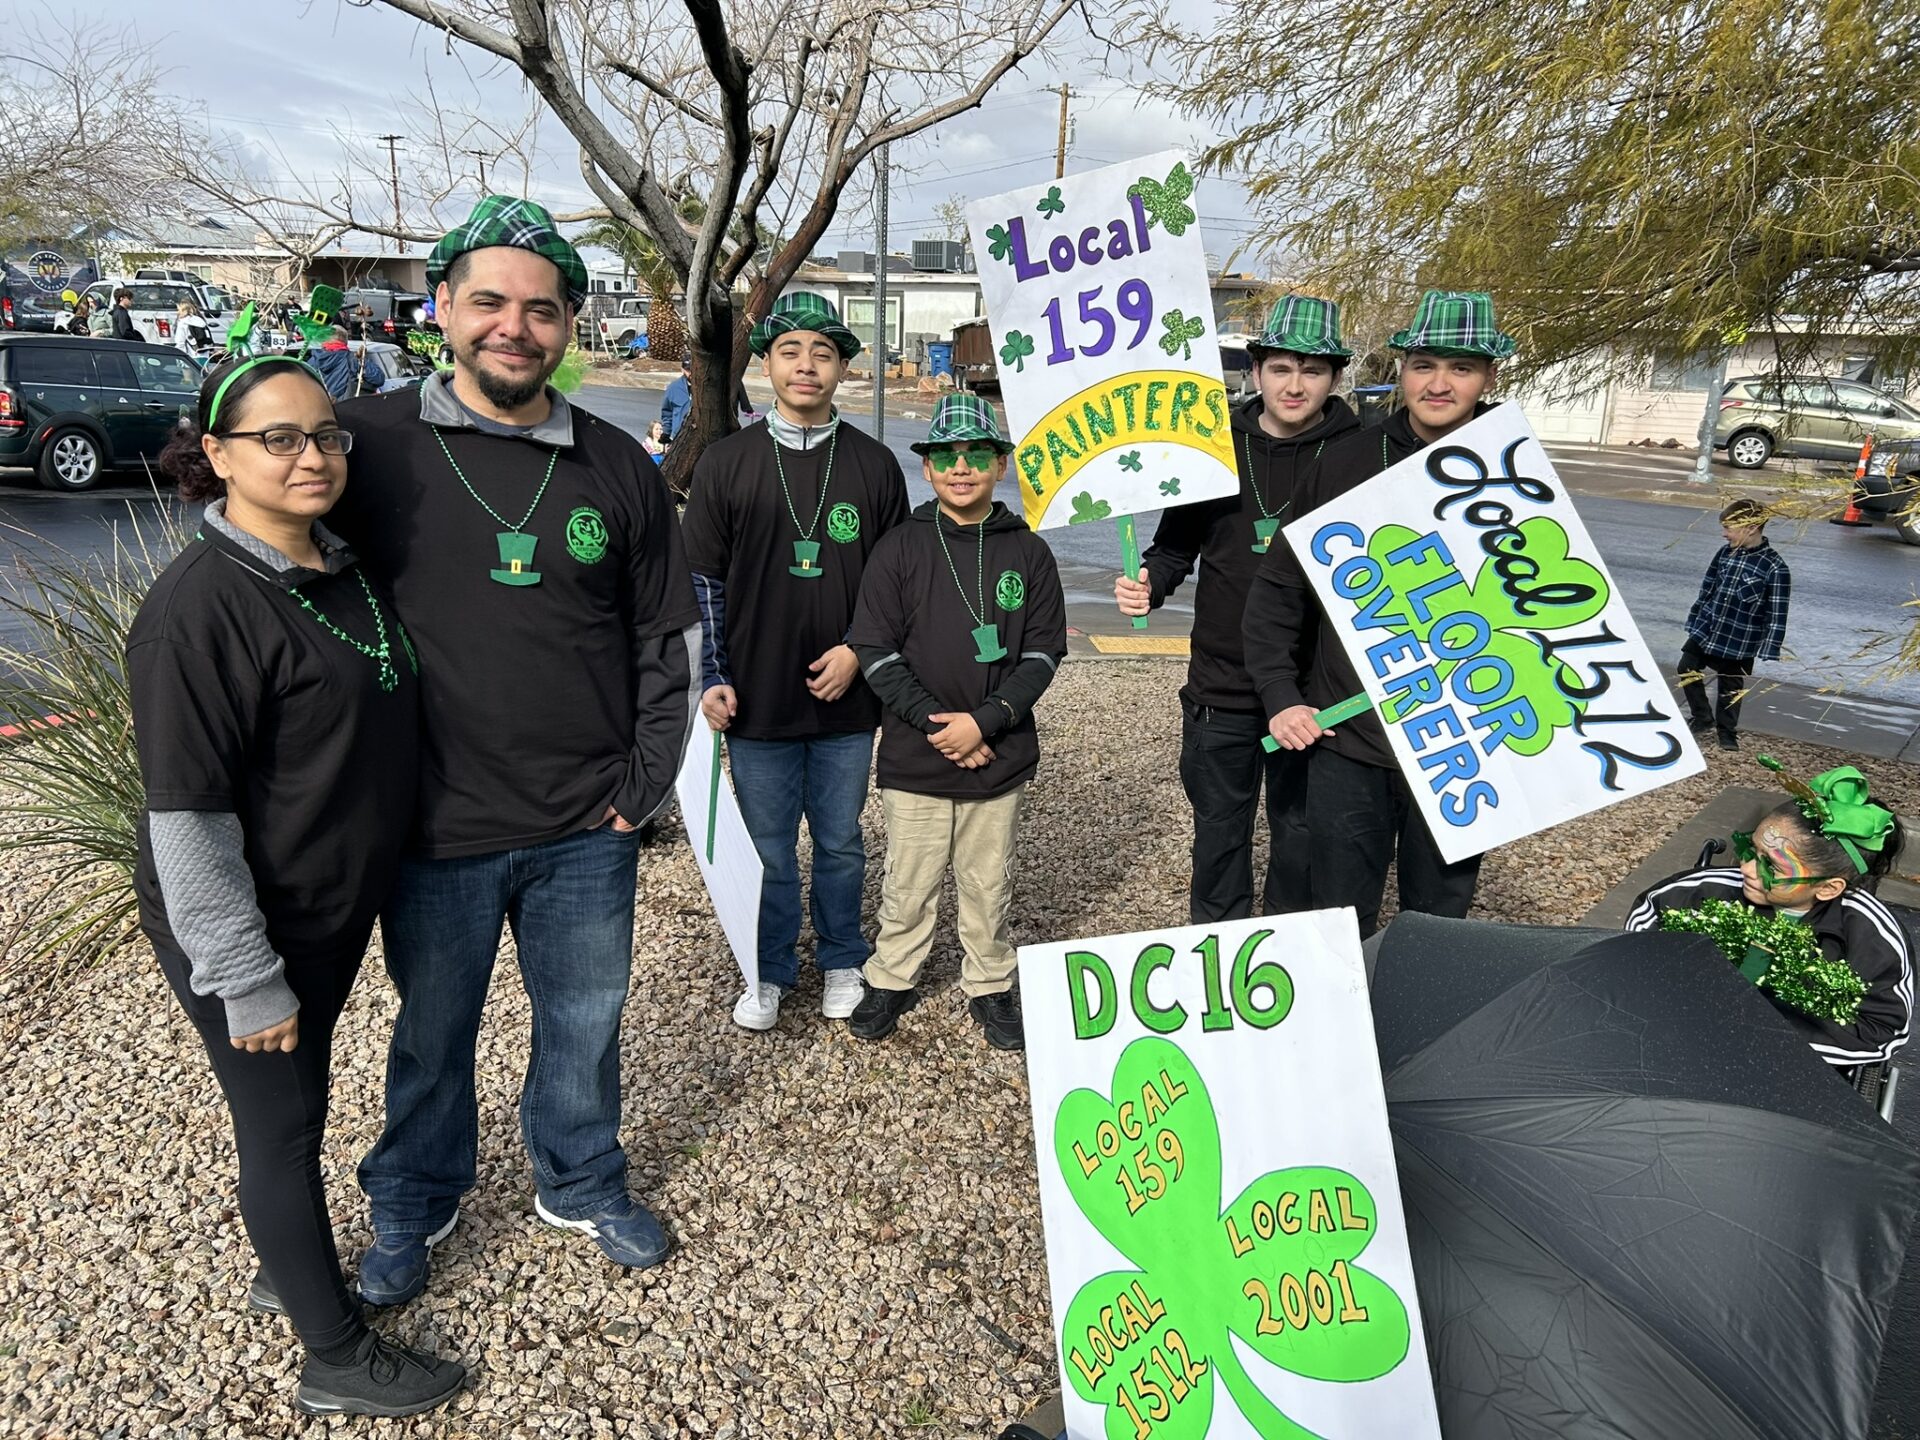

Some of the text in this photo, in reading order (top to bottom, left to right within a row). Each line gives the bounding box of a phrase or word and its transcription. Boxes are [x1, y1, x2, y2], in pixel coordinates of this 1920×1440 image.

[1007, 194, 1151, 283] Local
[272, 337, 286, 346] 83
[1041, 278, 1154, 366] 159
[1018, 381, 1225, 496] PAINTERS
[1386, 531, 1540, 756] FLOOR
[1425, 437, 1683, 792] Local 1512
[1310, 521, 1500, 827] COVERERS
[1072, 1068, 1189, 1180] LOCAL
[1115, 1128, 1185, 1217] 159
[1224, 1186, 1369, 1258] LOCAL
[1069, 1279, 1168, 1392] LOCAL
[1242, 1259, 1370, 1337] 2001
[1116, 1328, 1209, 1440] 1512
